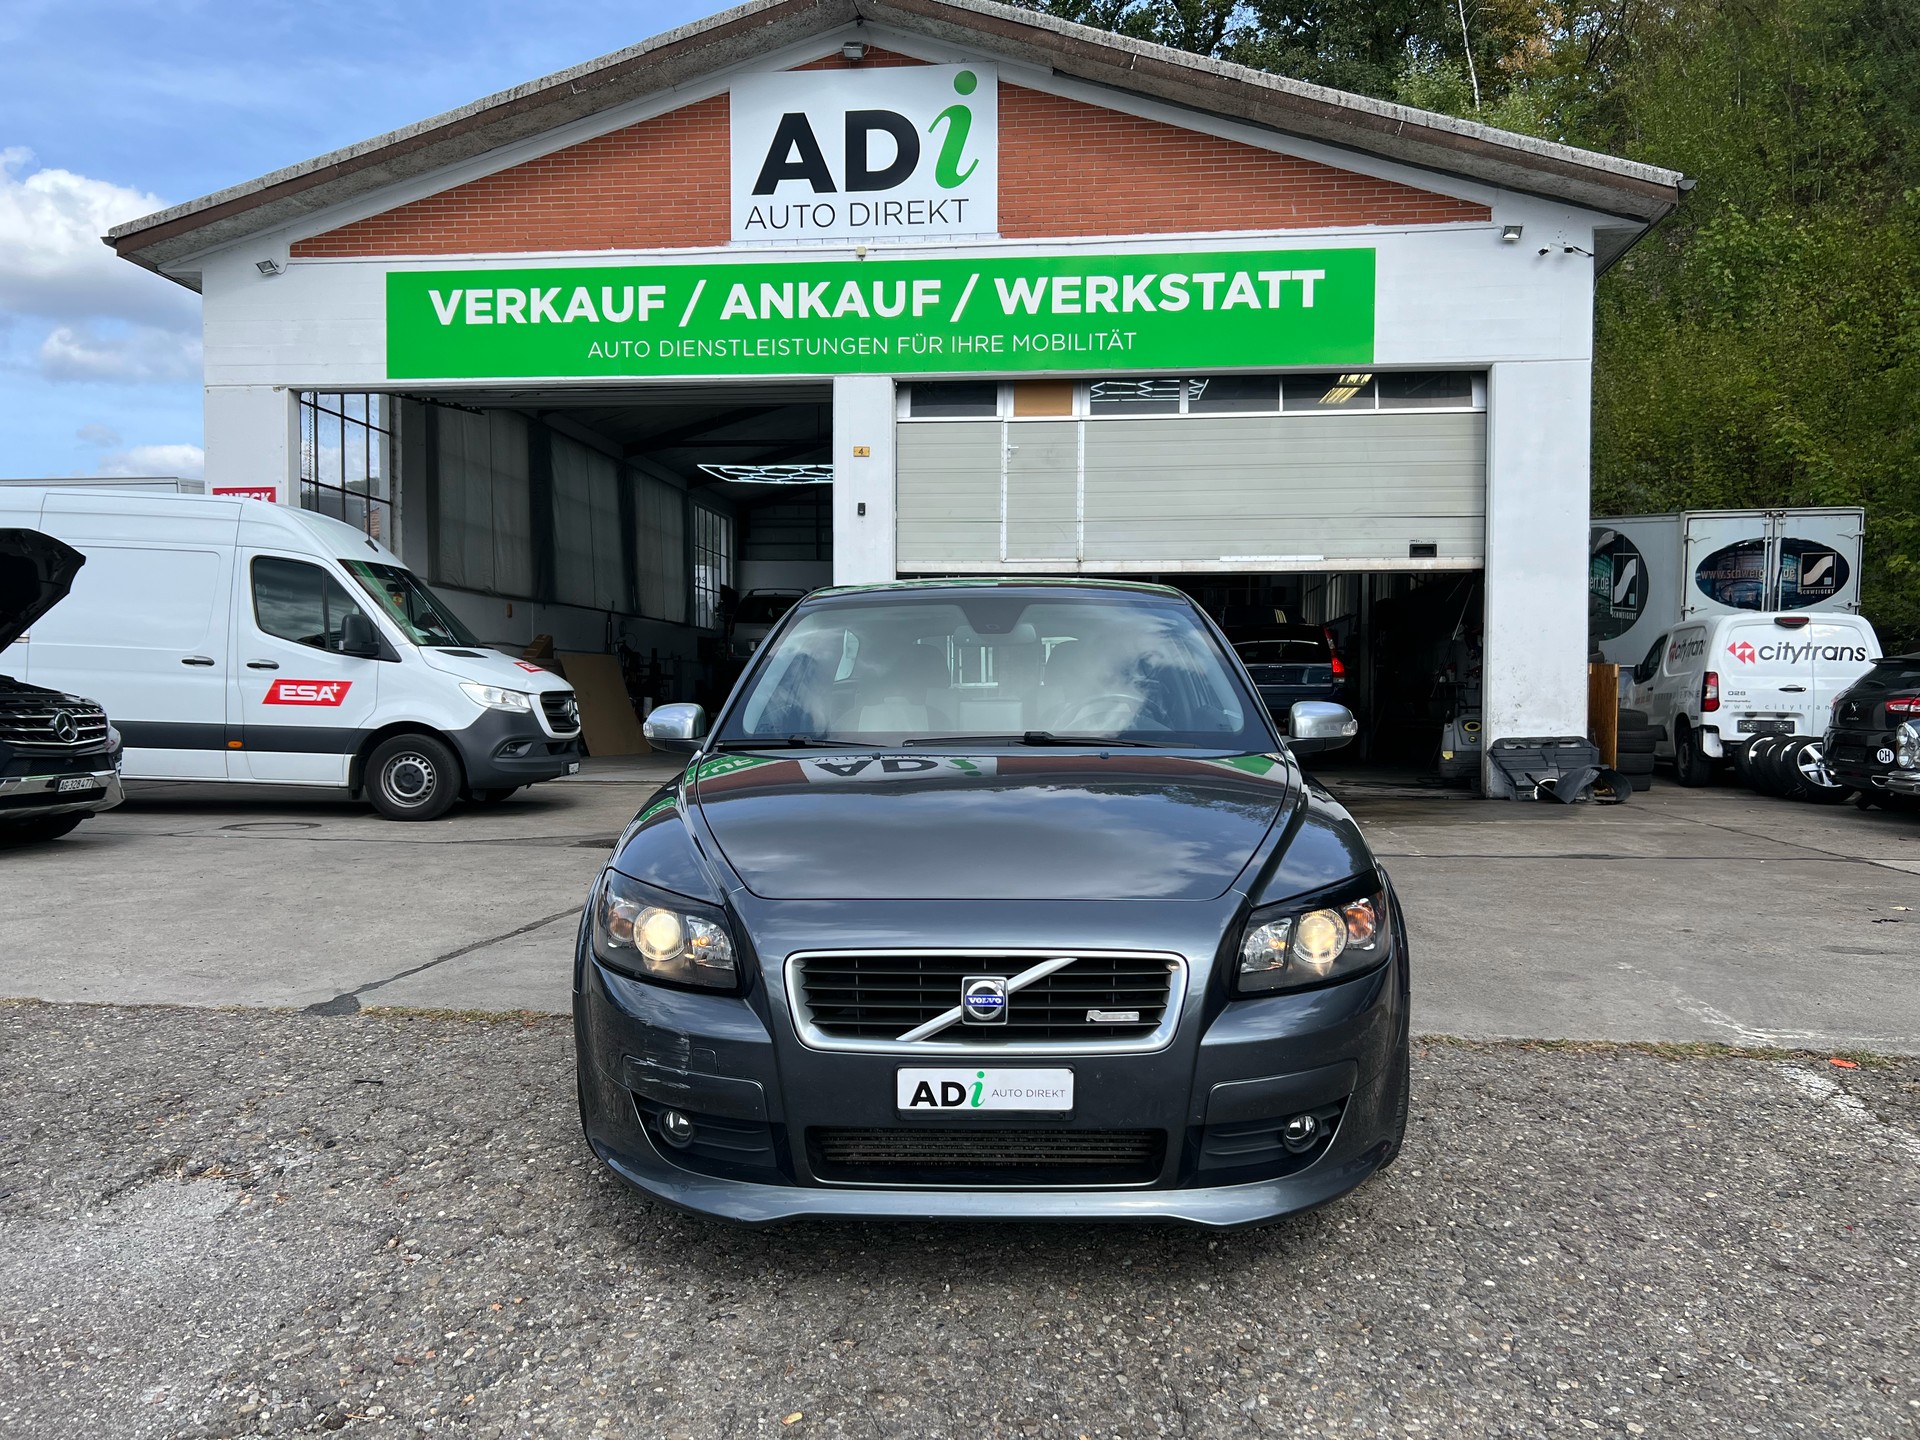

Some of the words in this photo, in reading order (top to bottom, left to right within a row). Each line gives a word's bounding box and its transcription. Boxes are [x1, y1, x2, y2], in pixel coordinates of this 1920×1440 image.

[751, 70, 979, 195] ADi
[745, 203, 836, 230] AUTO
[850, 198, 969, 227] DIREKT
[428, 284, 666, 326] VERKAUF
[678, 279, 707, 327] /
[719, 279, 942, 320] ANKAUF
[950, 273, 980, 322] /
[994, 269, 1326, 315] WERKSTATT
[587, 340, 651, 359] AUTO
[659, 336, 888, 358] DIENSTLEISTUNGEN
[897, 332, 943, 355] FÜR
[951, 334, 1004, 354] IHRE
[1013, 328, 1137, 352] MOBILITÄT
[1758, 641, 1867, 664] citytrans
[1879, 749, 1891, 761] CH
[909, 1071, 986, 1108] ADi
[991, 1088, 1023, 1098] AUTO
[1026, 1088, 1066, 1098] DIREKT
